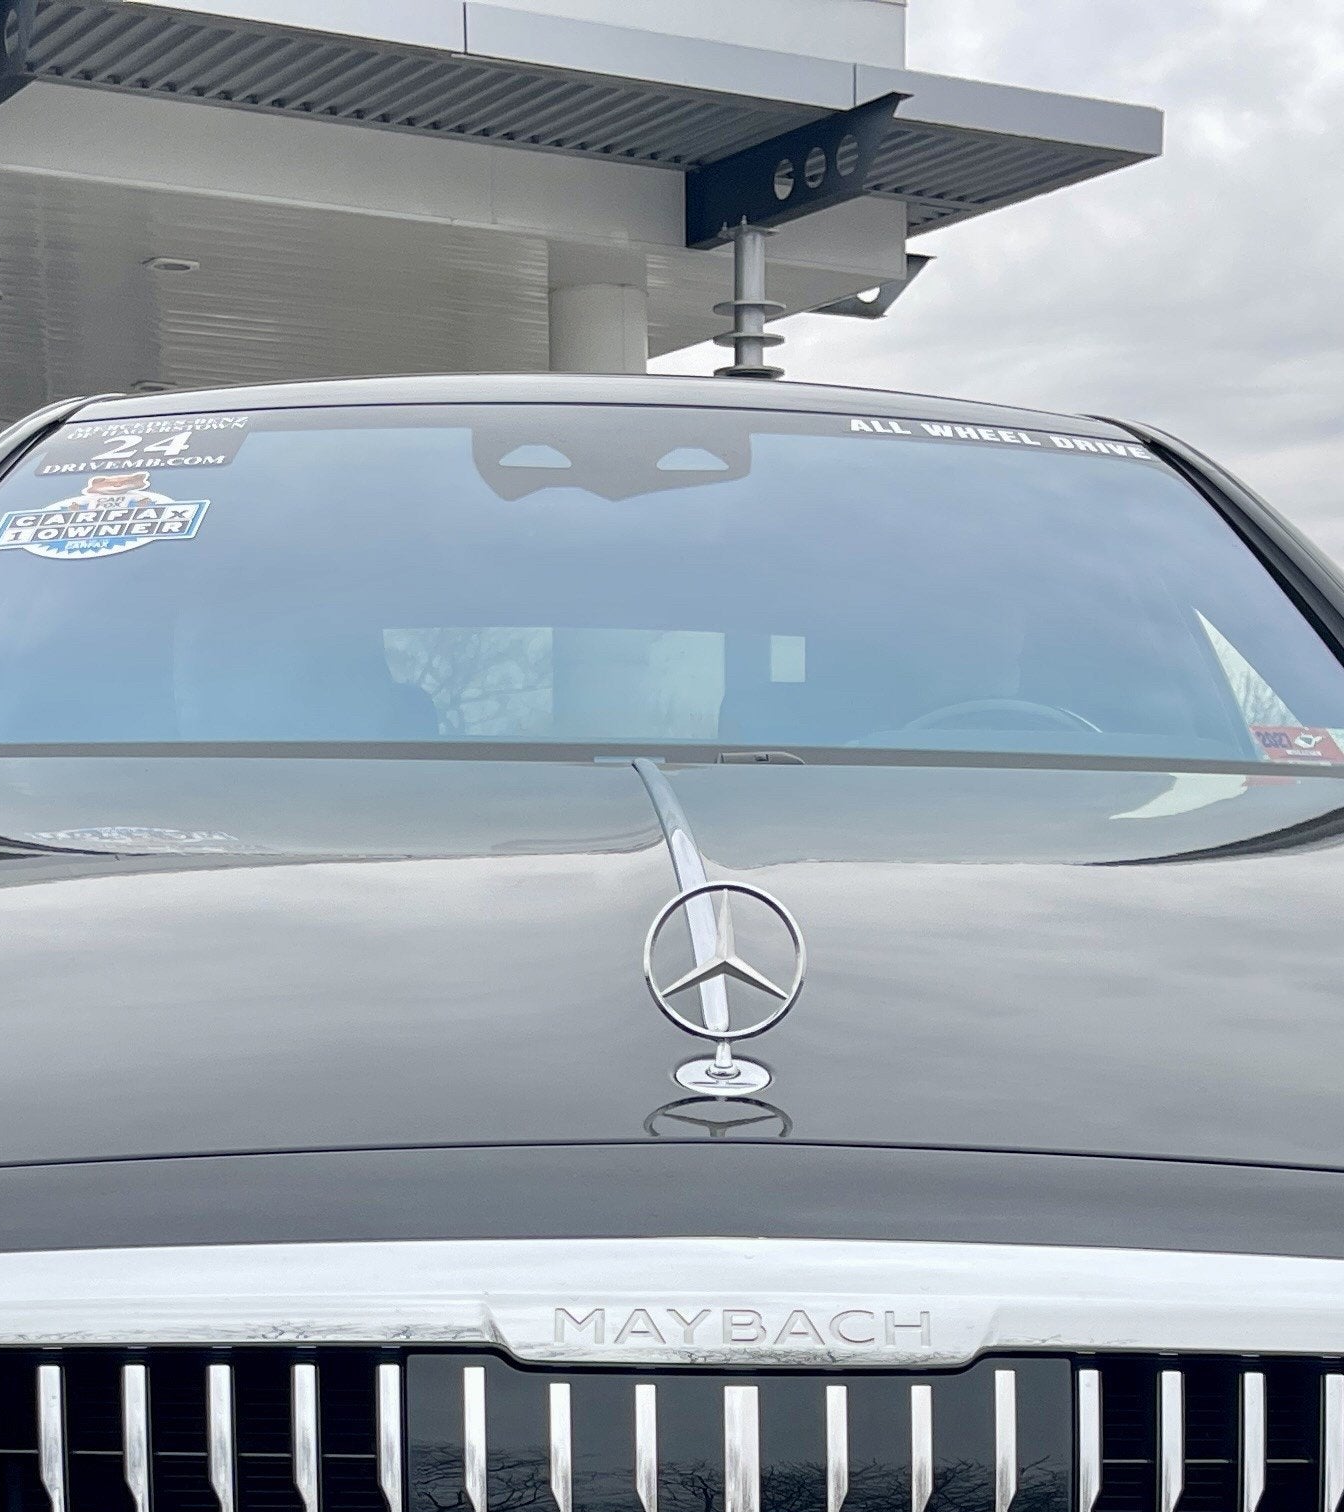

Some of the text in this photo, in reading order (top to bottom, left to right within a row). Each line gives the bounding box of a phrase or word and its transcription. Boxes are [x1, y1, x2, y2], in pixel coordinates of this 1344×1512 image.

[90, 431, 193, 461] 24
[850, 418, 1152, 460] ALL WHEEL DRIVE
[43, 455, 226, 475] DRIVEMB.COM
[16, 508, 190, 528] CARFAX
[7, 521, 183, 542] 1 OWNER
[554, 1307, 932, 1347] MAYBACH
